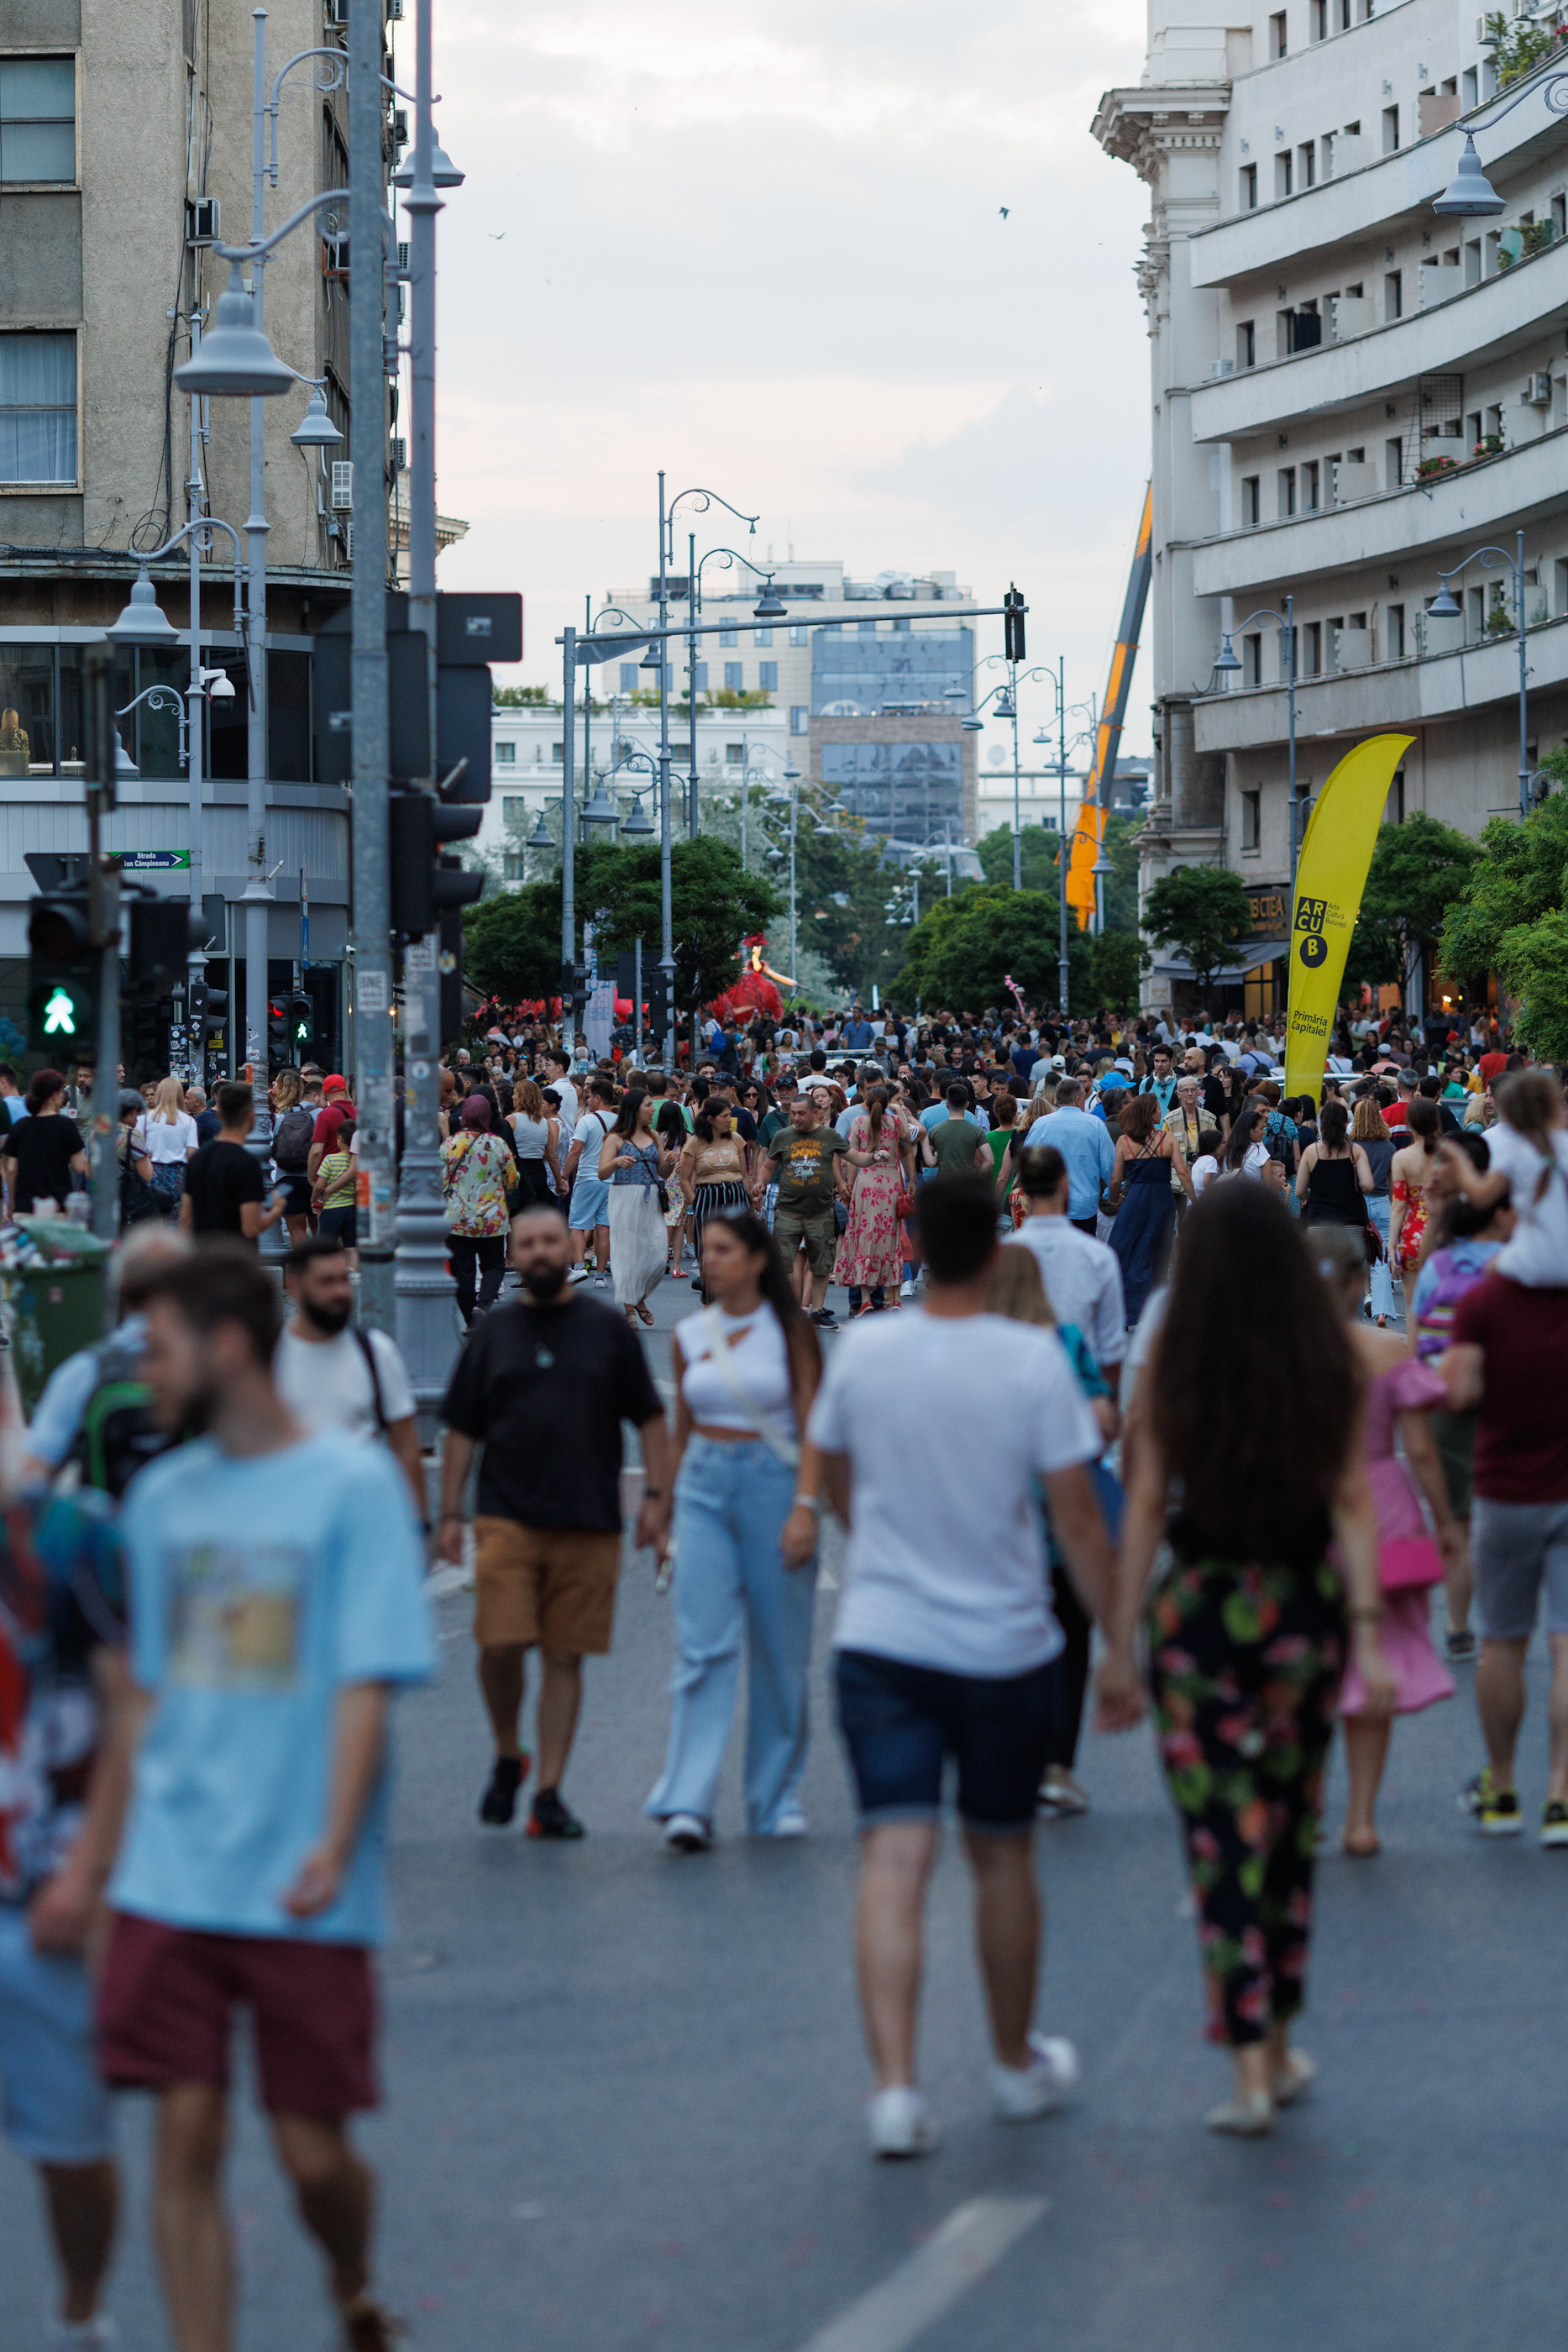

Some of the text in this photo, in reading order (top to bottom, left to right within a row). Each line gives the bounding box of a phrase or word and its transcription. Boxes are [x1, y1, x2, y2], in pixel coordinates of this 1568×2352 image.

[1327, 902, 1340, 911] Arte
[1326, 910, 1345, 920] Cultură
[1307, 938, 1319, 957] B
[1293, 1011, 1328, 1026] Primăria
[1291, 1021, 1327, 1037] Capitalei
[790, 1139, 821, 1150] ADVENTURE
